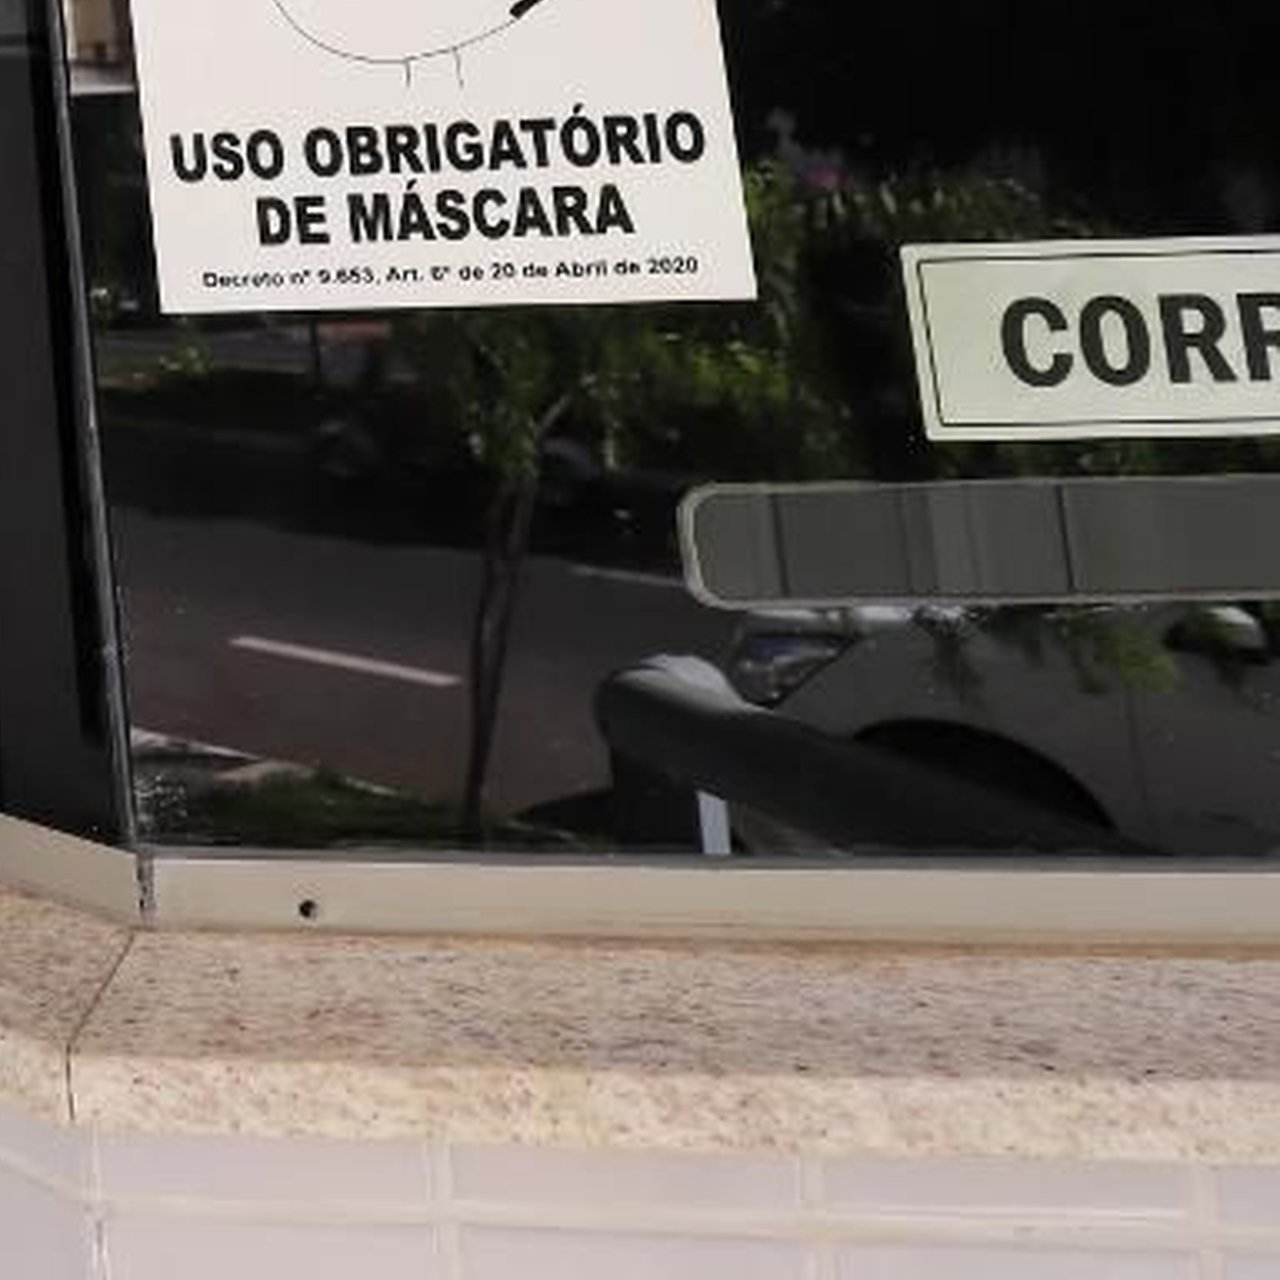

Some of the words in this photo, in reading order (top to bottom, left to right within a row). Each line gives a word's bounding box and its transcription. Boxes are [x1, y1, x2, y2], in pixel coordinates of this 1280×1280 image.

[169, 128, 285, 183] USO
[302, 103, 706, 178] OBRIGATÓRIO
[255, 195, 331, 246] DE
[347, 178, 637, 244] MÁSCARA
[202, 271, 285, 288] Decreto
[386, 266, 424, 283] Art.
[458, 264, 485, 281] de
[491, 261, 516, 280] 20
[522, 261, 549, 279] de
[554, 259, 608, 278] Abril
[613, 257, 641, 275] de
[647, 256, 699, 275] 2020
